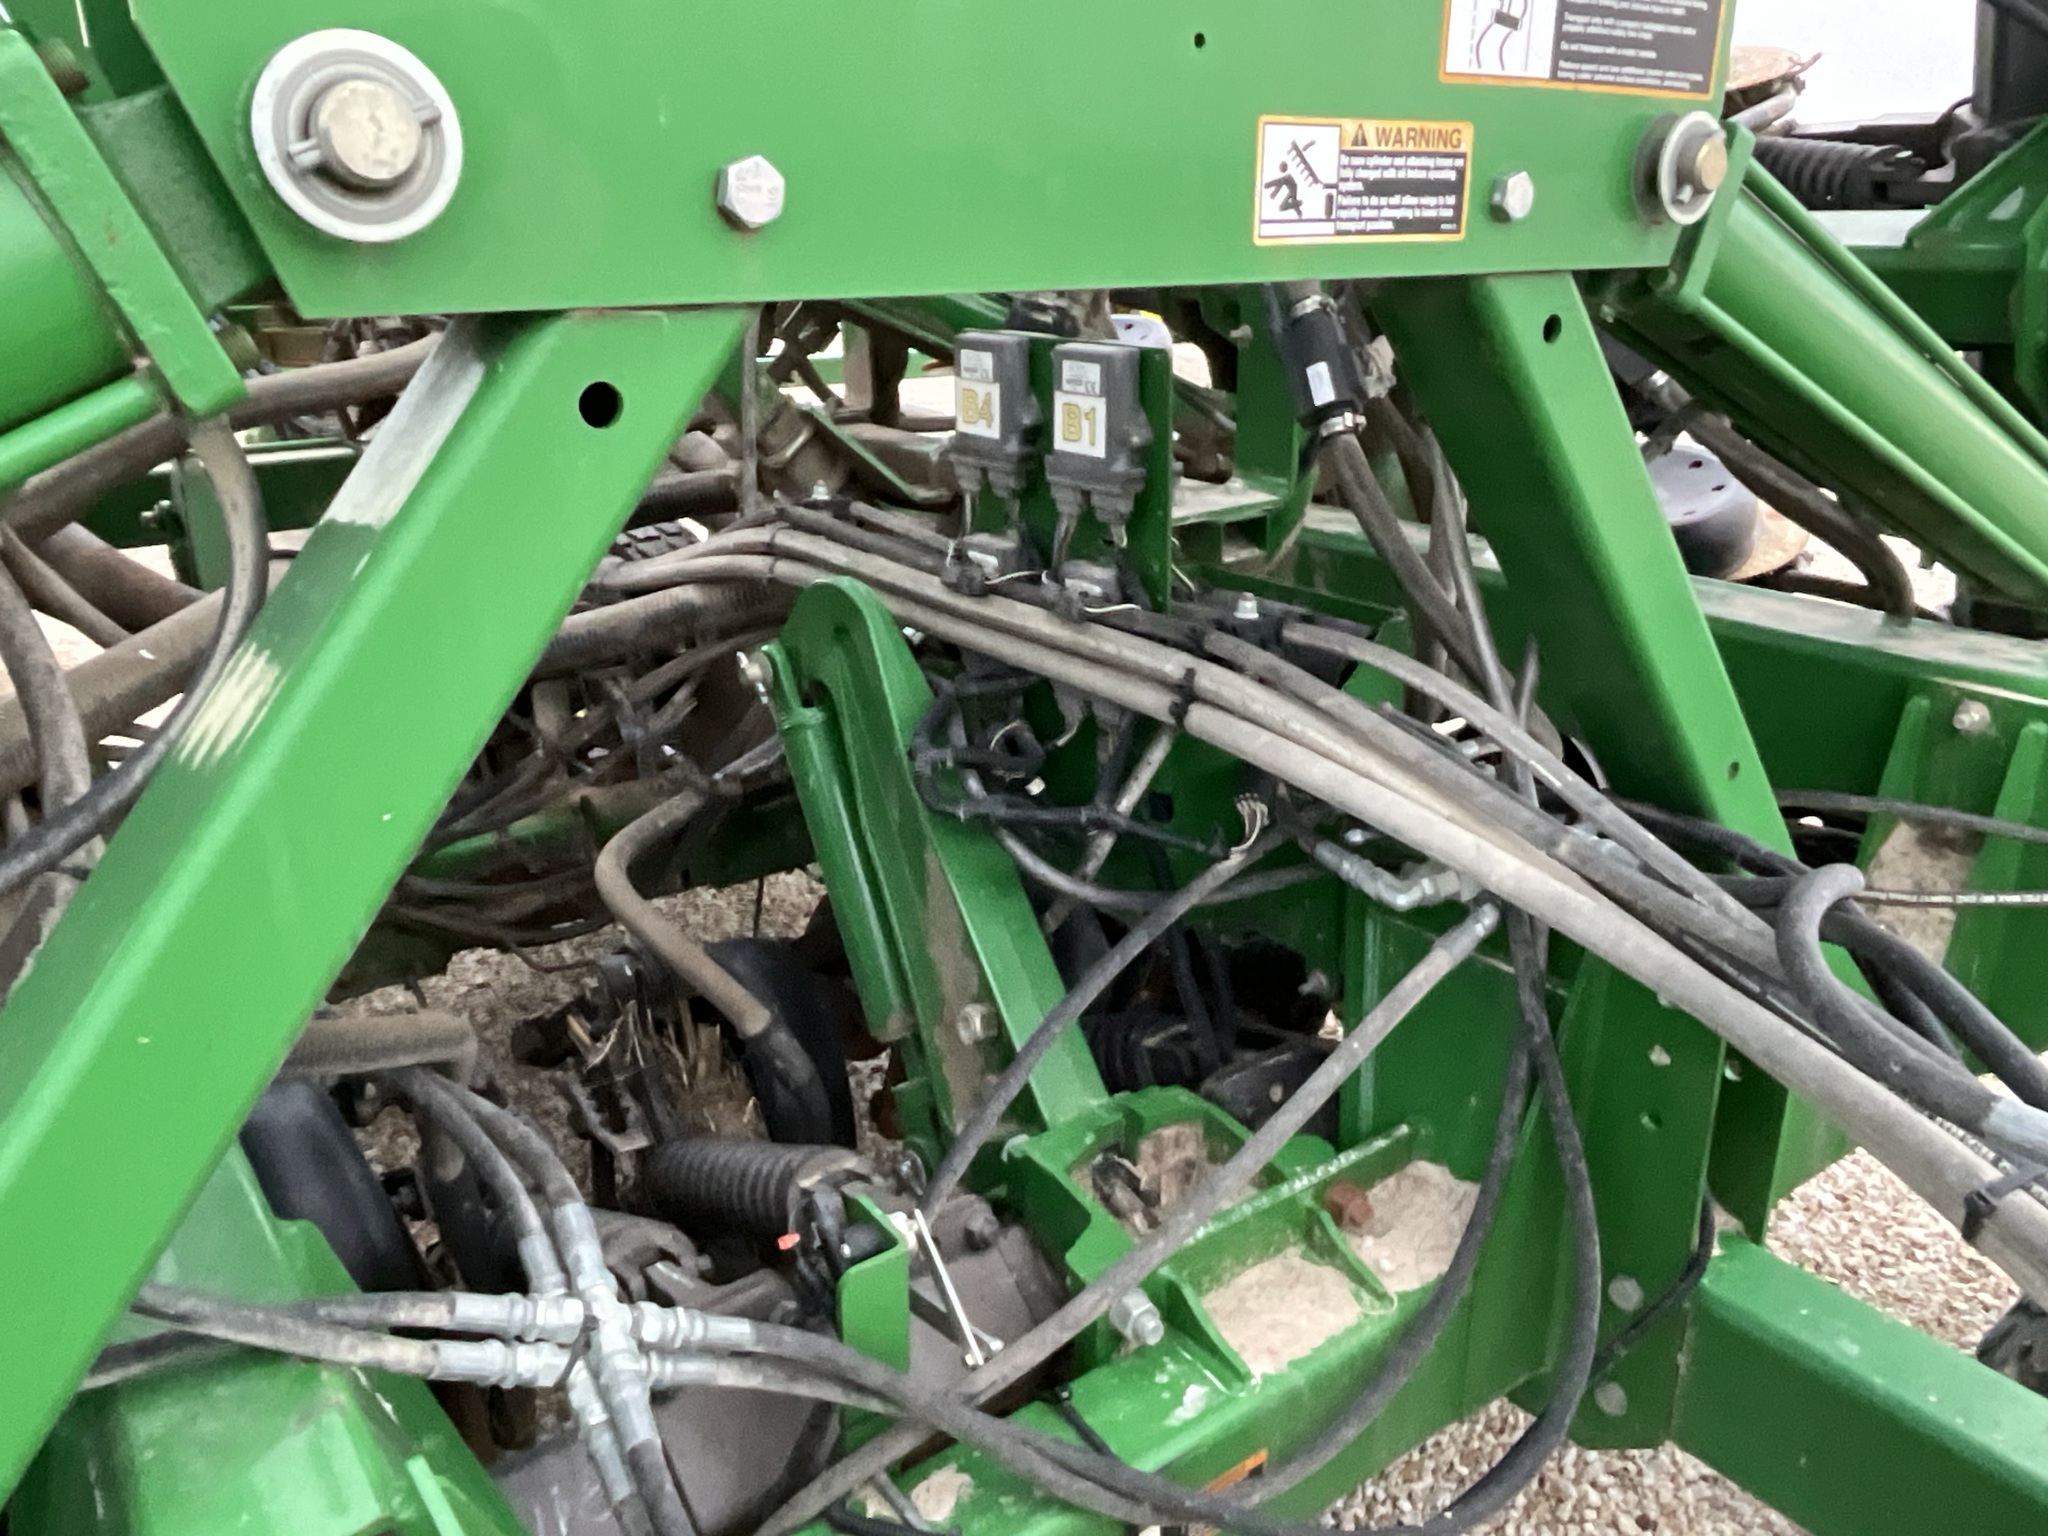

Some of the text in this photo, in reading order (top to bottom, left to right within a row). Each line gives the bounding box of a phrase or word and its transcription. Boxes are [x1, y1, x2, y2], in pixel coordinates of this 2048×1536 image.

[1375, 126, 1462, 149] WARNING
[962, 388, 993, 428] B4
[1062, 402, 1096, 446] B1
